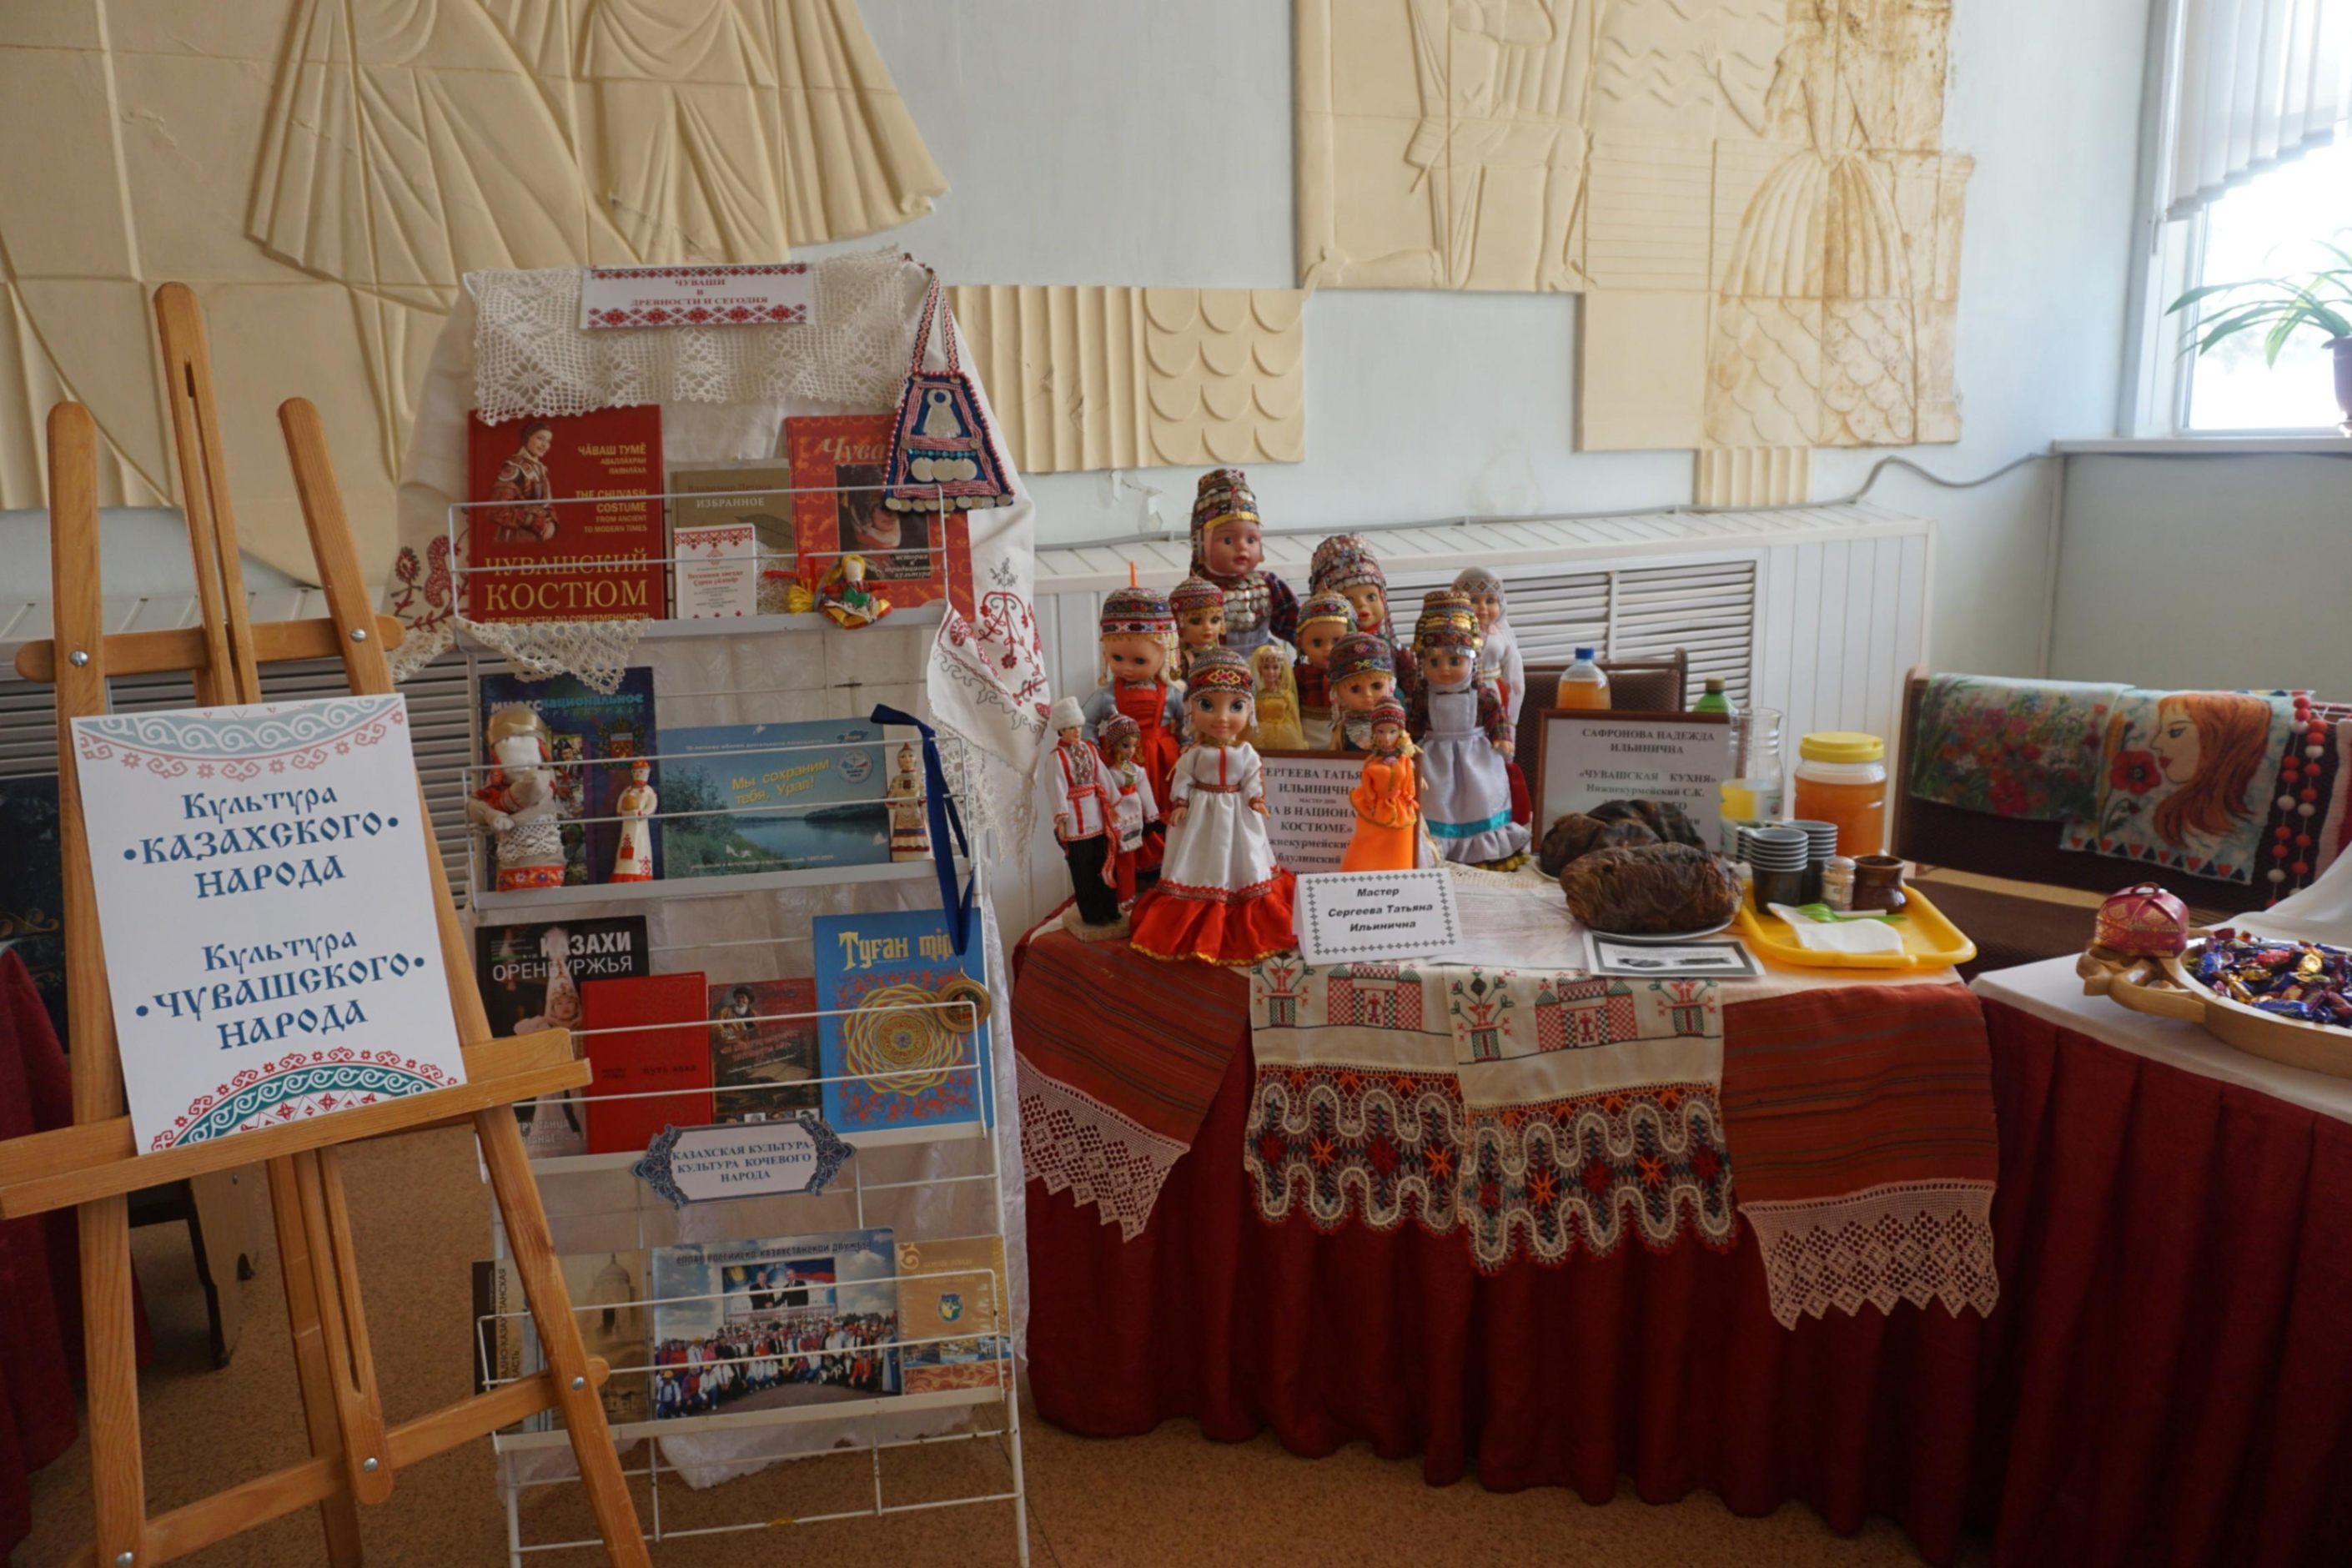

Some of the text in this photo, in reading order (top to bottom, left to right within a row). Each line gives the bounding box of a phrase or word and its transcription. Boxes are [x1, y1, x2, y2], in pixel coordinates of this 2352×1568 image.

[630, 298, 701, 307] ДРЕВНОСТИ
[714, 296, 768, 305] СЕГОДНЯ
[575, 488, 646, 500] THE CHUVASH
[596, 502, 646, 513] COSTUME
[696, 497, 765, 508] ИЗБРАННОЕ
[584, 525, 592, 534] TO
[485, 547, 648, 576] ЧУВАШСКИЙ
[485, 580, 648, 611] КОСТЮМ
[1582, 728, 1715, 741] САФРОНОВА НАДЕЖДА
[1611, 743, 1684, 754] ИЛЬИНИЧНА
[731, 776, 756, 791] Мы
[761, 759, 831, 785] сохраним
[1579, 769, 1717, 783] «ЧУВАШСКАЯ КУХНЯ»
[776, 775, 815, 799] Урал!
[182, 786, 339, 821] Культура
[1284, 806, 1292, 815] В
[141, 811, 383, 864] КАЗАХСКОГО
[194, 855, 346, 899] НАРОДА
[1357, 887, 1400, 897] Мастер
[1328, 903, 1433, 918] Сергеева Татьяна
[1349, 921, 1416, 932] Ильинична
[201, 931, 357, 974] Культура
[153, 952, 410, 1022] ЧУВАШСКОГО
[217, 999, 368, 1051] НАРОДА
[672, 1146, 745, 1160] КАЗАХСКАЯ
[677, 1153, 812, 1173] КУЛЬТУРА КОЧЕВОГО
[721, 1171, 771, 1183] НАРОДА
